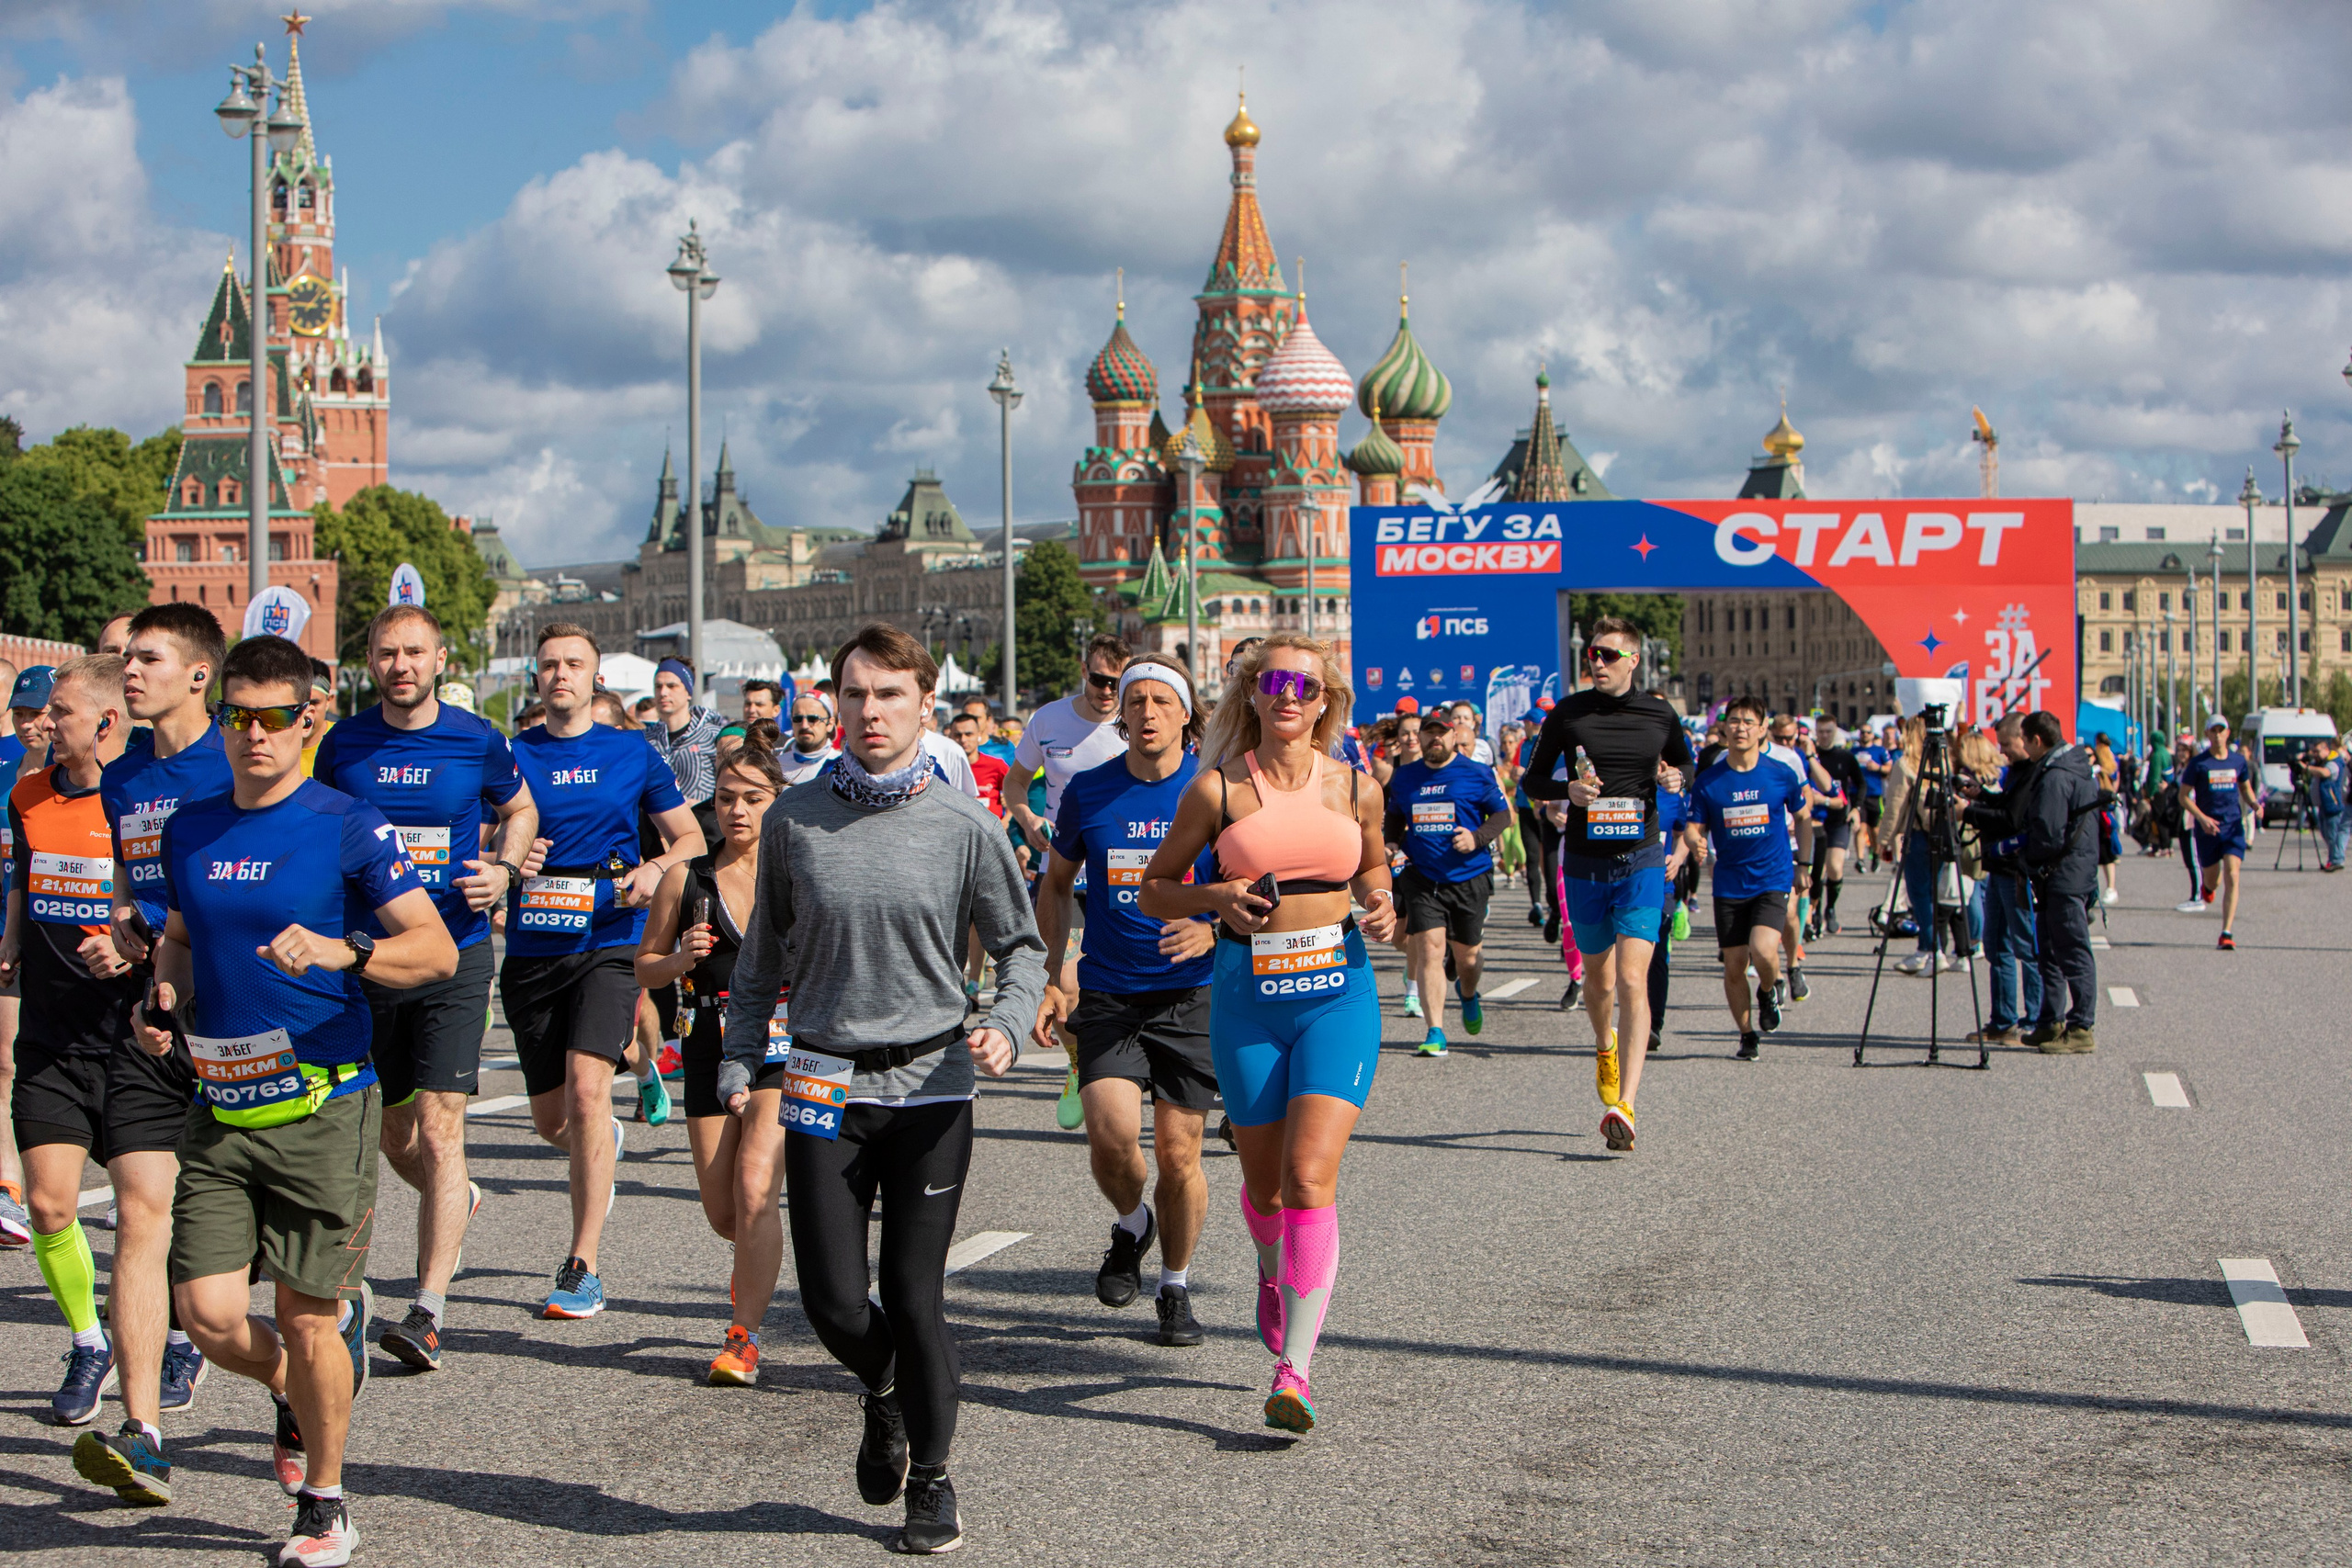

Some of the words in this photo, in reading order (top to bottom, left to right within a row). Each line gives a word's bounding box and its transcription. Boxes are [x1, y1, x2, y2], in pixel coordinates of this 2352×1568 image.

[1375, 514, 1492, 542] БЕГУ
[1502, 513, 1563, 540] ЗА
[1713, 512, 2024, 567] СТАРТ
[1382, 544, 1557, 571] МОСКВУ
[1445, 618, 1489, 635] ПСБ
[1984, 629, 2041, 680] ЗА
[1593, 825, 1639, 835] 03122
[1731, 826, 1765, 836] 01001
[33, 898, 110, 919] 02505
[521, 911, 588, 928] 00378
[1261, 972, 1345, 995] 02620
[207, 1076, 300, 1104] 00763
[834, 1090, 843, 1101] D
[779, 1100, 835, 1131] 02964
